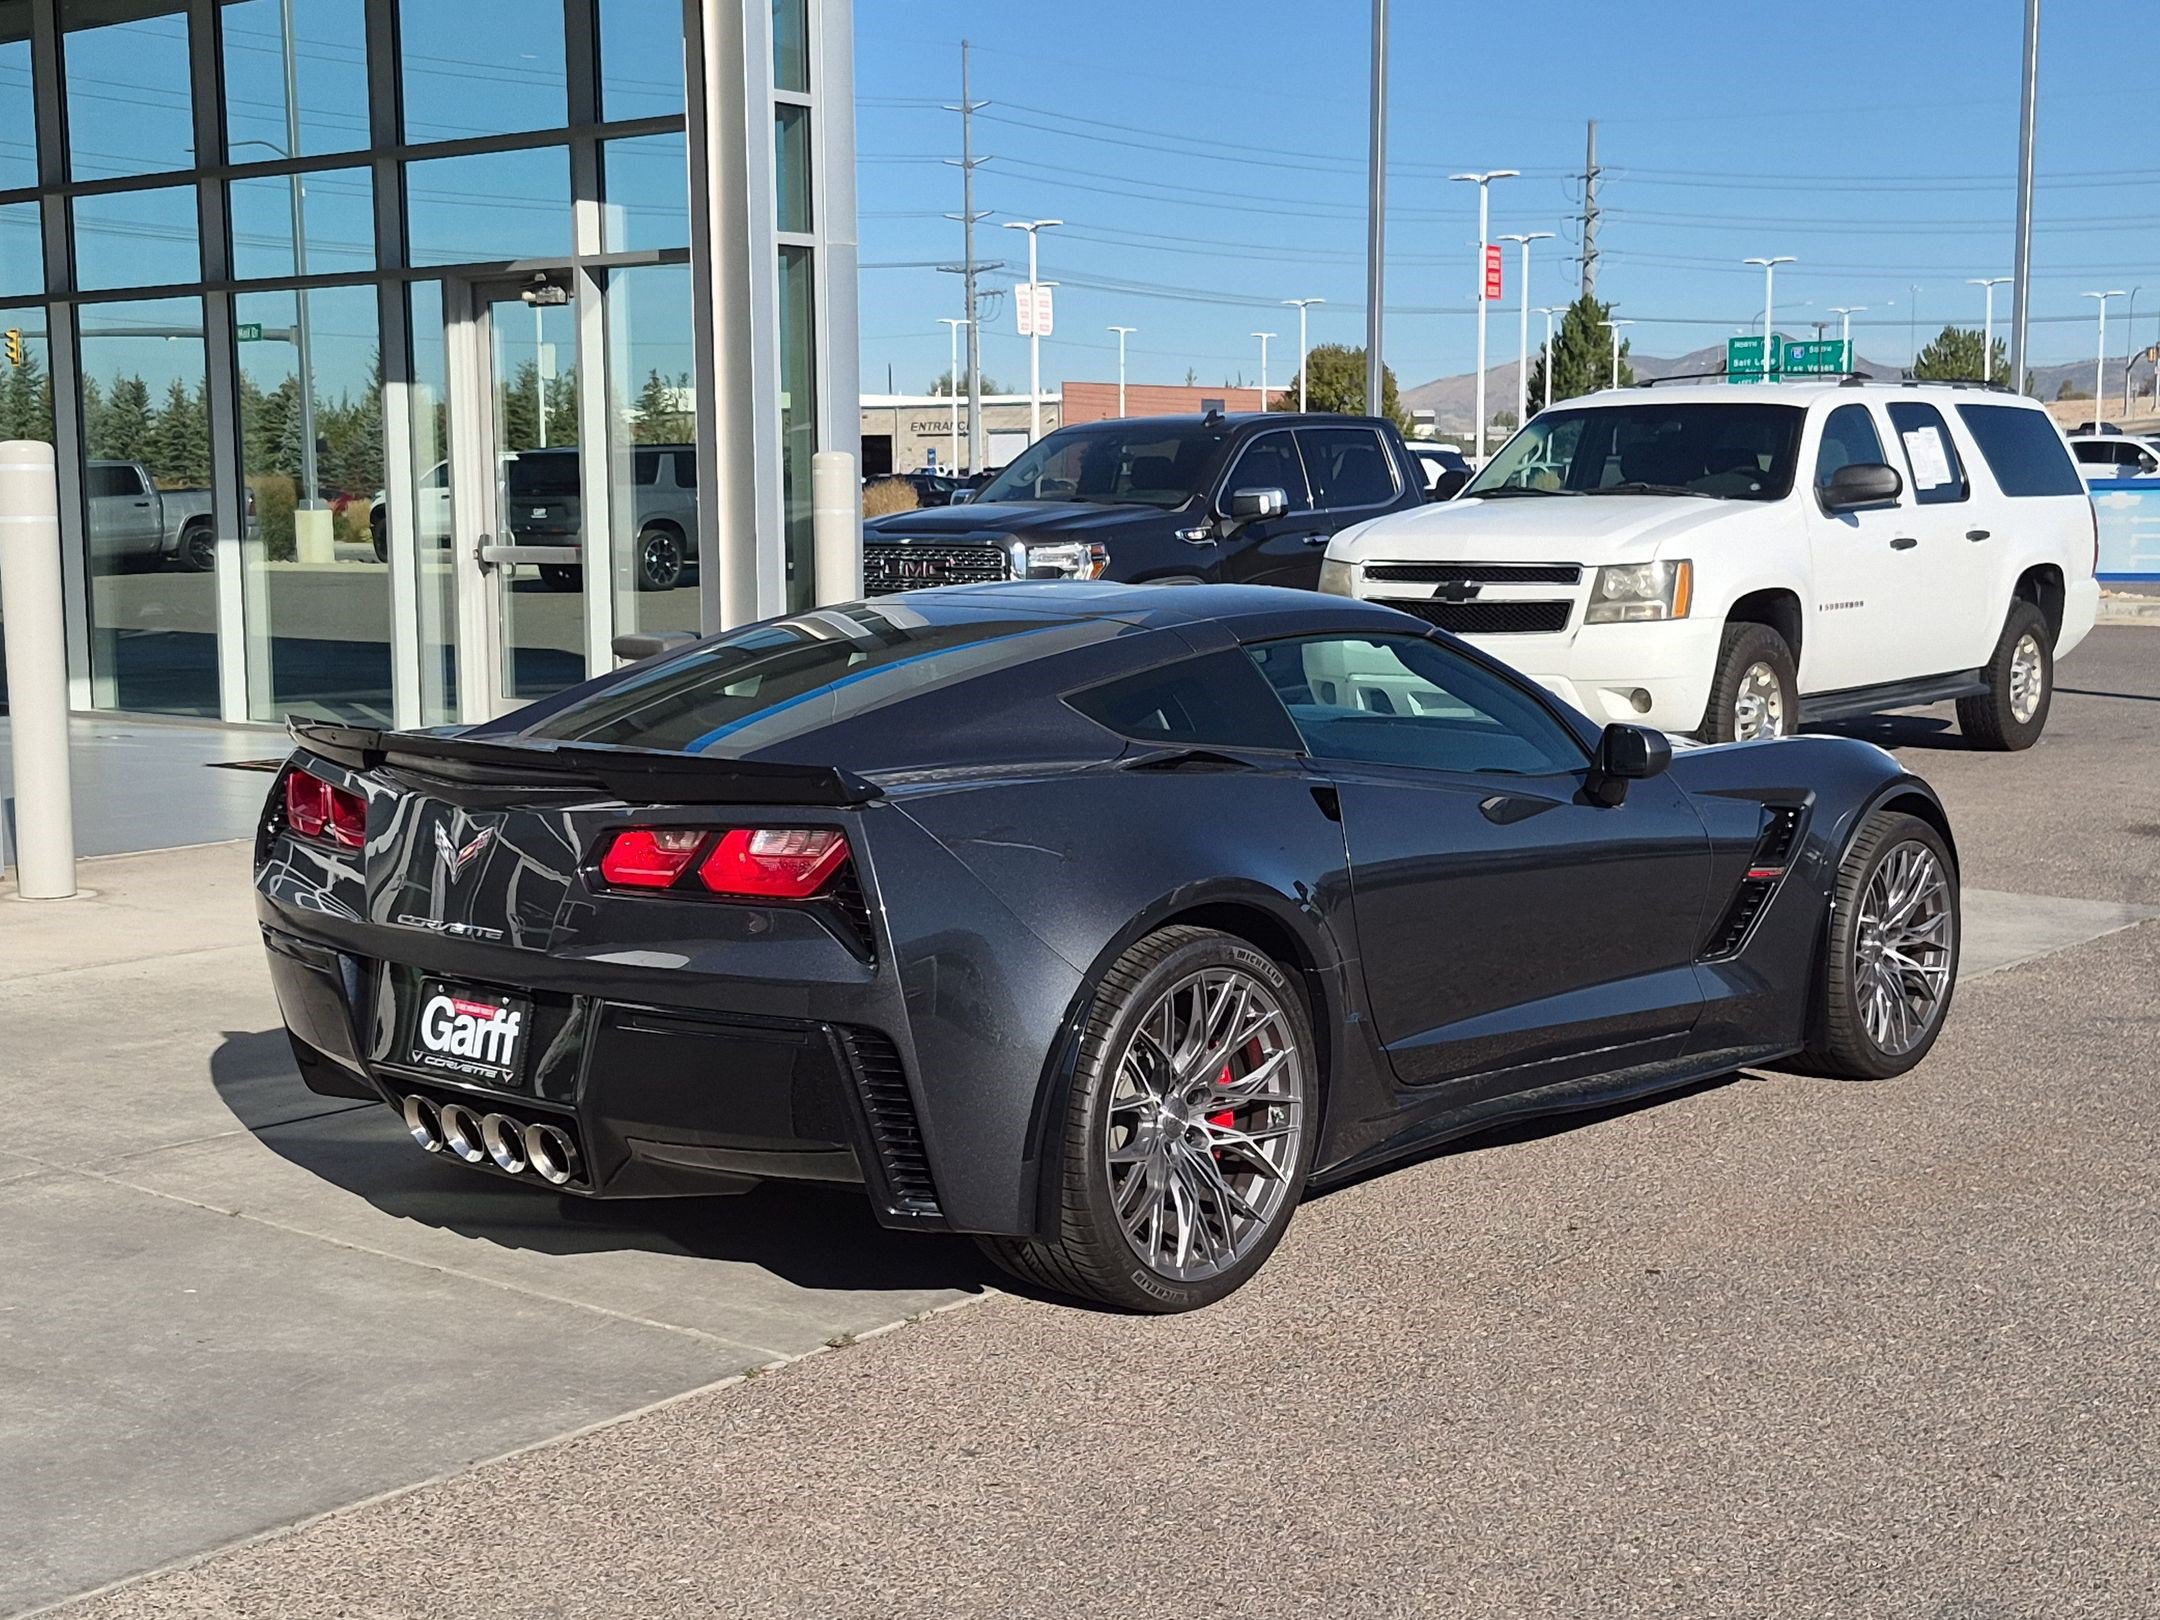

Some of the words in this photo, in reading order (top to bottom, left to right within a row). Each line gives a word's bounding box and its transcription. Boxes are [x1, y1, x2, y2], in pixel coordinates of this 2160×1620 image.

[910, 421, 970, 432] ENTRAC
[880, 558, 951, 581] GMC
[397, 914, 504, 940] CORVETTE
[1236, 949, 1283, 985] MICHELIN
[421, 995, 521, 1066] Garff
[424, 1056, 498, 1079] CORVETTE
